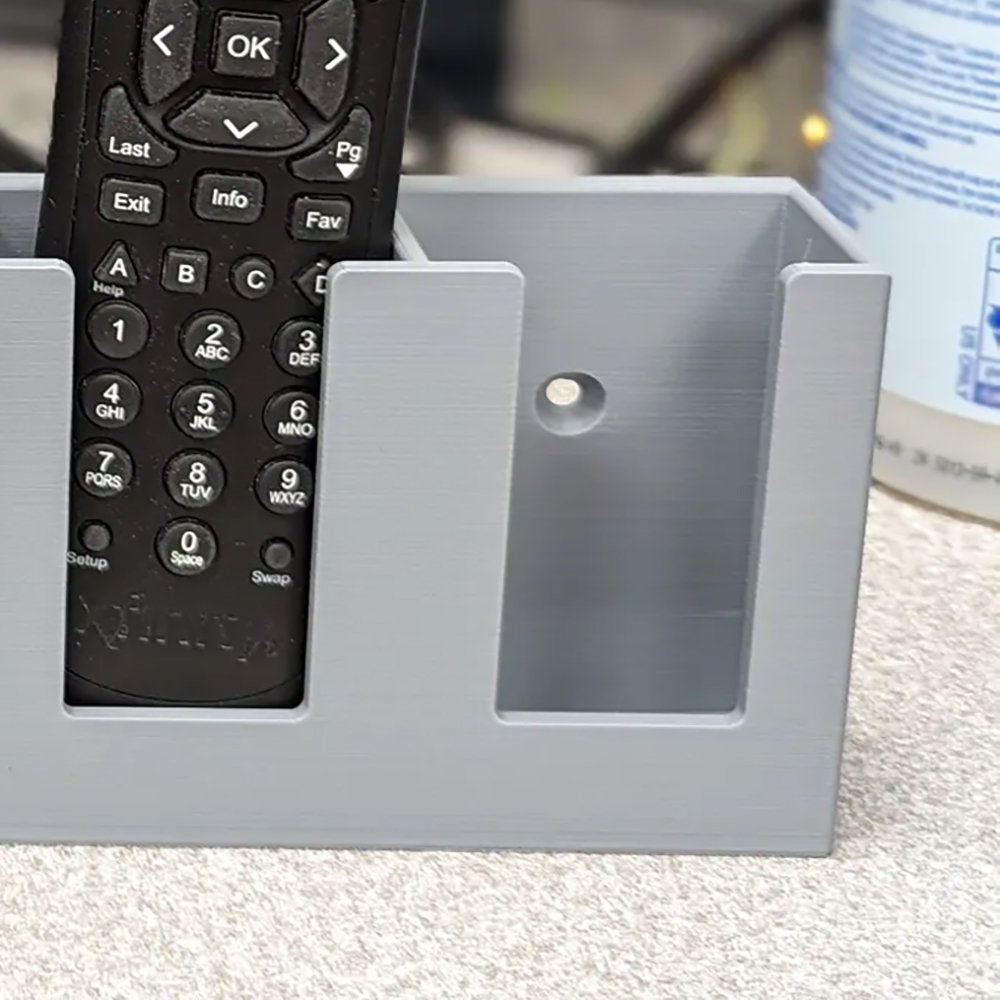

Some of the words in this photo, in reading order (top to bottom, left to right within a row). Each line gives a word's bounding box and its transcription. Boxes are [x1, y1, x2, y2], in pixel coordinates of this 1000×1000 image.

[227, 35, 271, 60] OK
[109, 137, 151, 158] Last
[336, 142, 362, 161] Pg
[113, 193, 150, 213] Exit
[212, 189, 249, 208] Info
[305, 212, 342, 230] Fav
[109, 258, 129, 277] A
[177, 265, 195, 283] B
[247, 270, 266, 289] C
[112, 320, 125, 342] 1
[206, 324, 225, 345] 2
[299, 330, 317, 351] 3
[195, 345, 230, 361] ABC
[289, 352, 320, 366] DEF
[104, 383, 121, 404] 4
[95, 405, 125, 421] GHI
[198, 393, 216, 414] 5
[290, 400, 307, 421] 6
[189, 416, 218, 431] JKL
[277, 422, 314, 437] MNO
[98, 450, 115, 472] 7
[85, 472, 123, 489] PQRS
[189, 462, 206, 484] 8
[280, 468, 298, 490] 9
[180, 484, 212, 500] TUV
[269, 491, 306, 506] WXYZ
[180, 531, 198, 552] 0
[66, 552, 109, 571] Setup
[170, 551, 204, 567] Space
[251, 570, 292, 587] Swap
